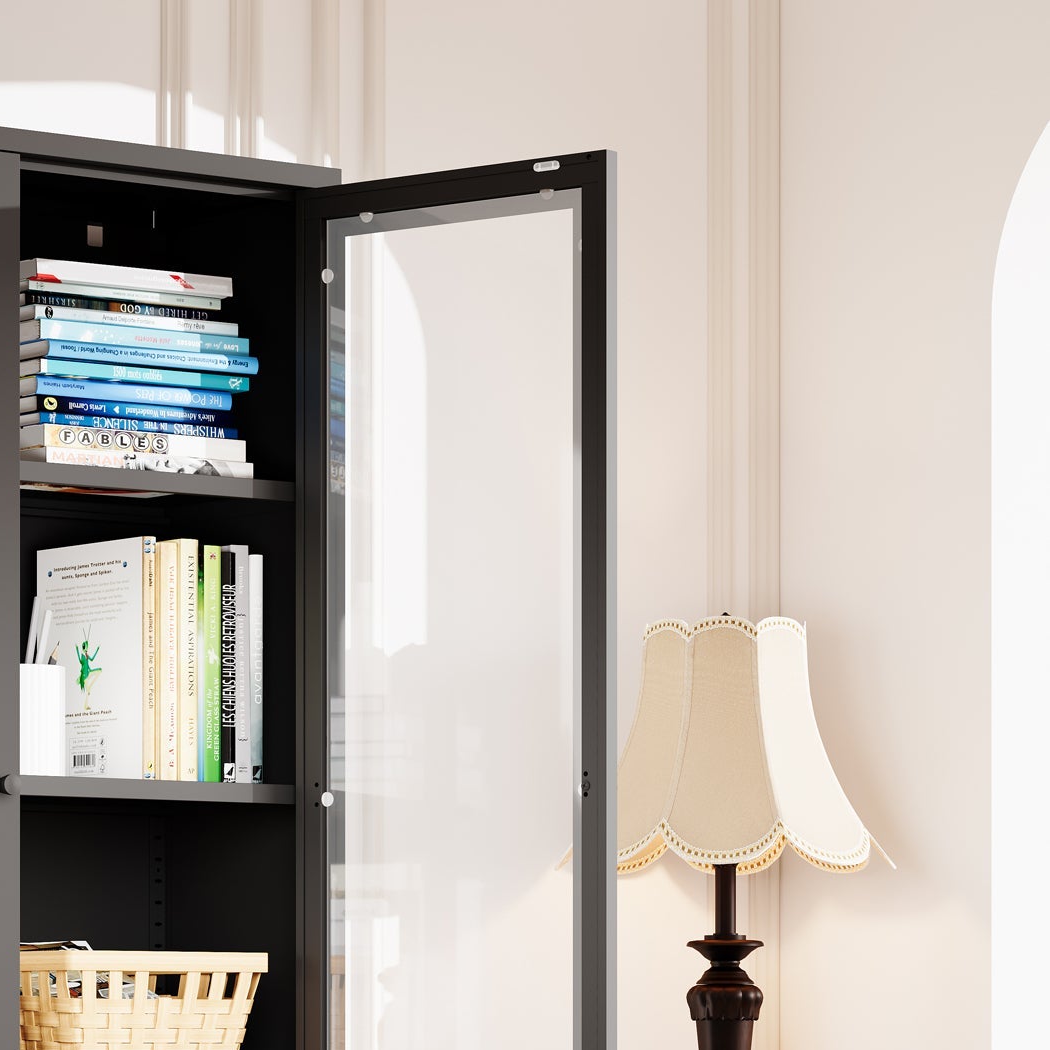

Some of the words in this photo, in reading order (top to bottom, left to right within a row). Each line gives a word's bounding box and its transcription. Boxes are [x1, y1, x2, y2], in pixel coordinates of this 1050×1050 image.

[120, 303, 141, 313] GOD
[159, 308, 187, 318] HIRED
[95, 347, 119, 357] Changing
[223, 343, 239, 352] Love
[129, 350, 156, 360] Challenges
[157, 353, 166, 361] and
[167, 354, 186, 362] Choices
[232, 360, 249, 368] Energy
[68, 401, 89, 411] Carroll
[89, 404, 106, 412] Lewis
[197, 413, 216, 422] Alice's
[92, 416, 139, 431] SILENCE
[143, 421, 159, 430] THE
[159, 421, 168, 430] IN
[173, 423, 225, 438] WHISPERS
[61, 431, 165, 450] FABLES
[187, 555, 195, 623] EXISTENTIAL
[222, 584, 236, 641] RETROVISEUR
[187, 629, 195, 697] ASPIRATIONS
[222, 679, 236, 712] CHIENS
[222, 712, 236, 728] LES
